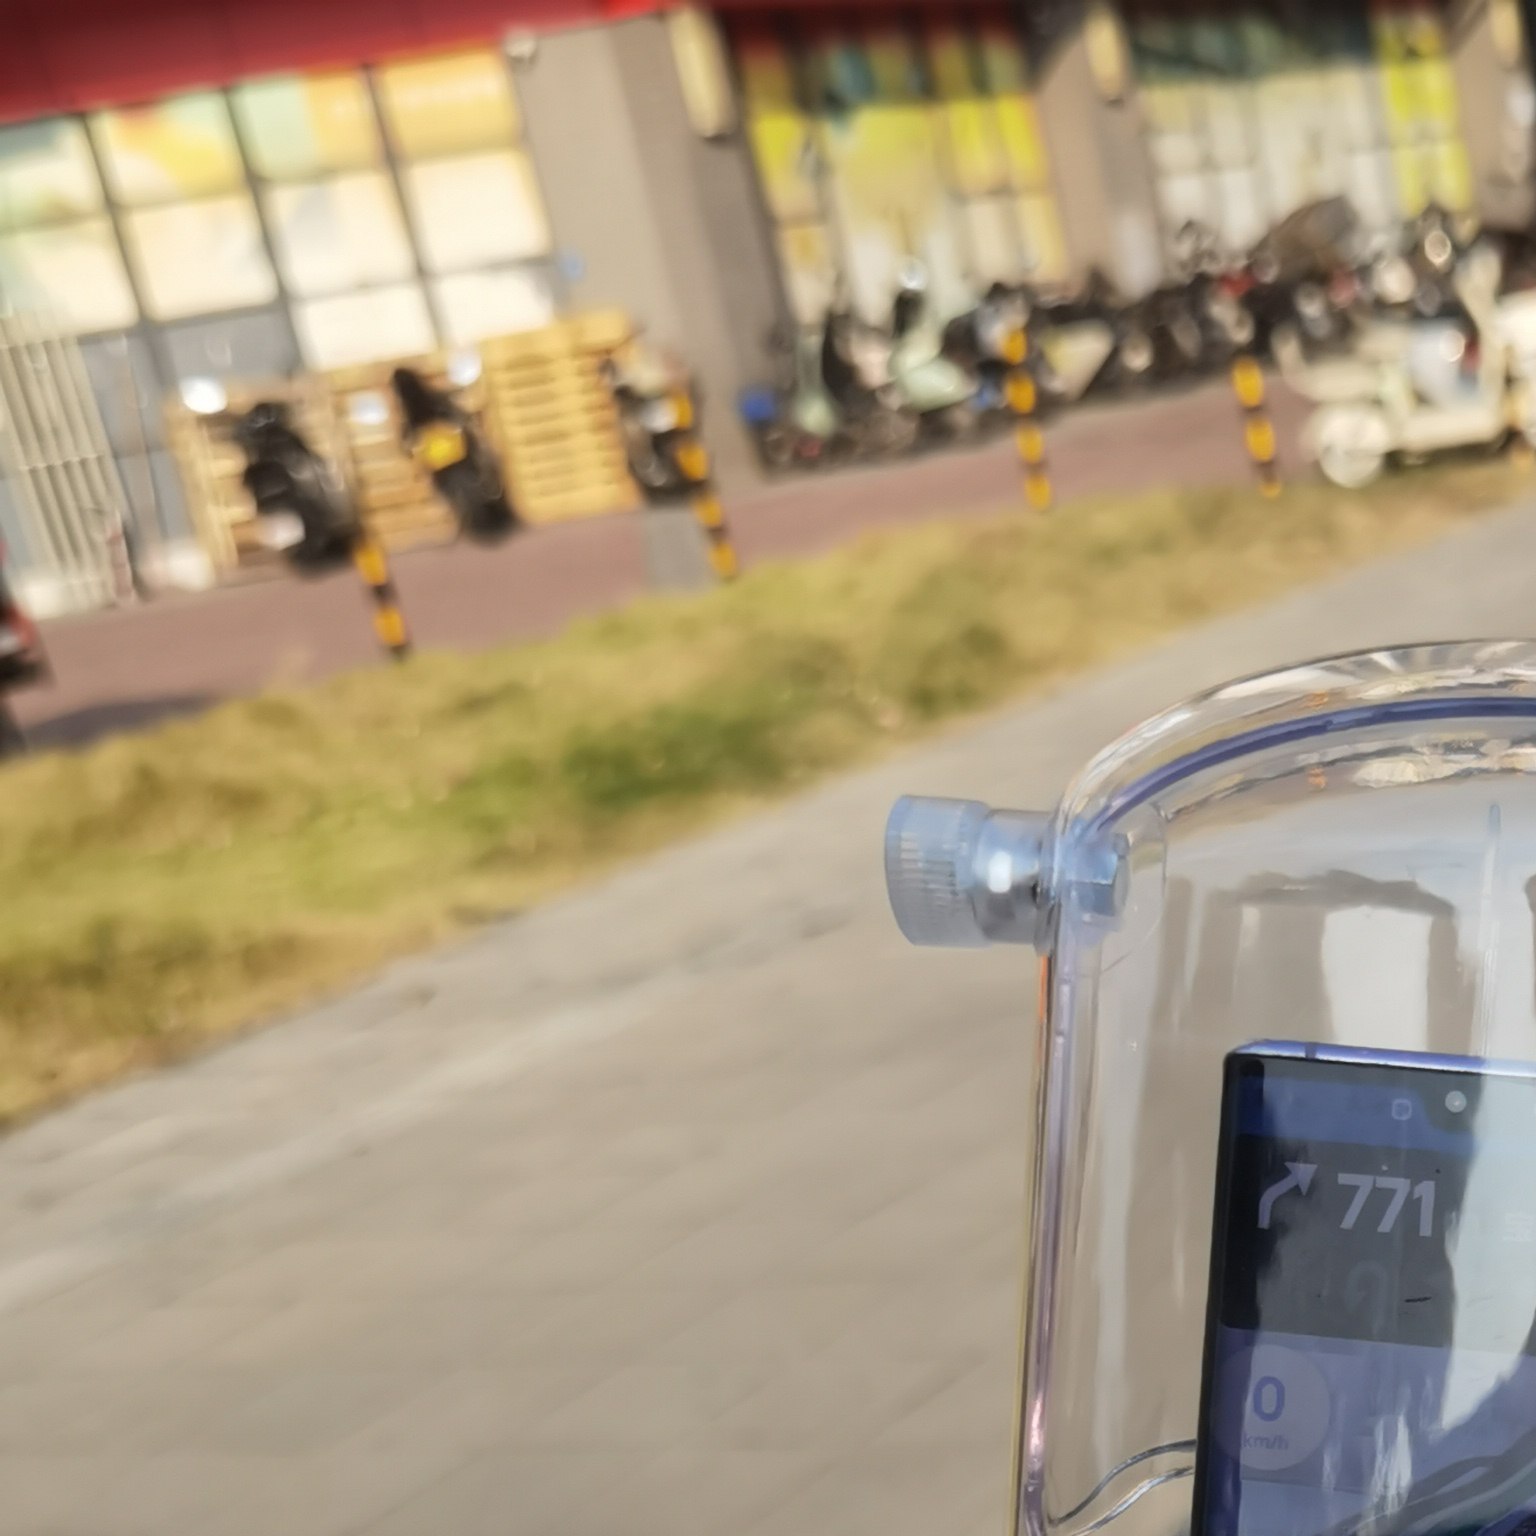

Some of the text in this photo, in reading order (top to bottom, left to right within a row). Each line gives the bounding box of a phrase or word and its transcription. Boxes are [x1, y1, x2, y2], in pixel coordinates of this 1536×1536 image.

[1338, 1173, 1436, 1237] 771
[1253, 1376, 1286, 1422] 0
[1242, 1433, 1289, 1450] km/h
